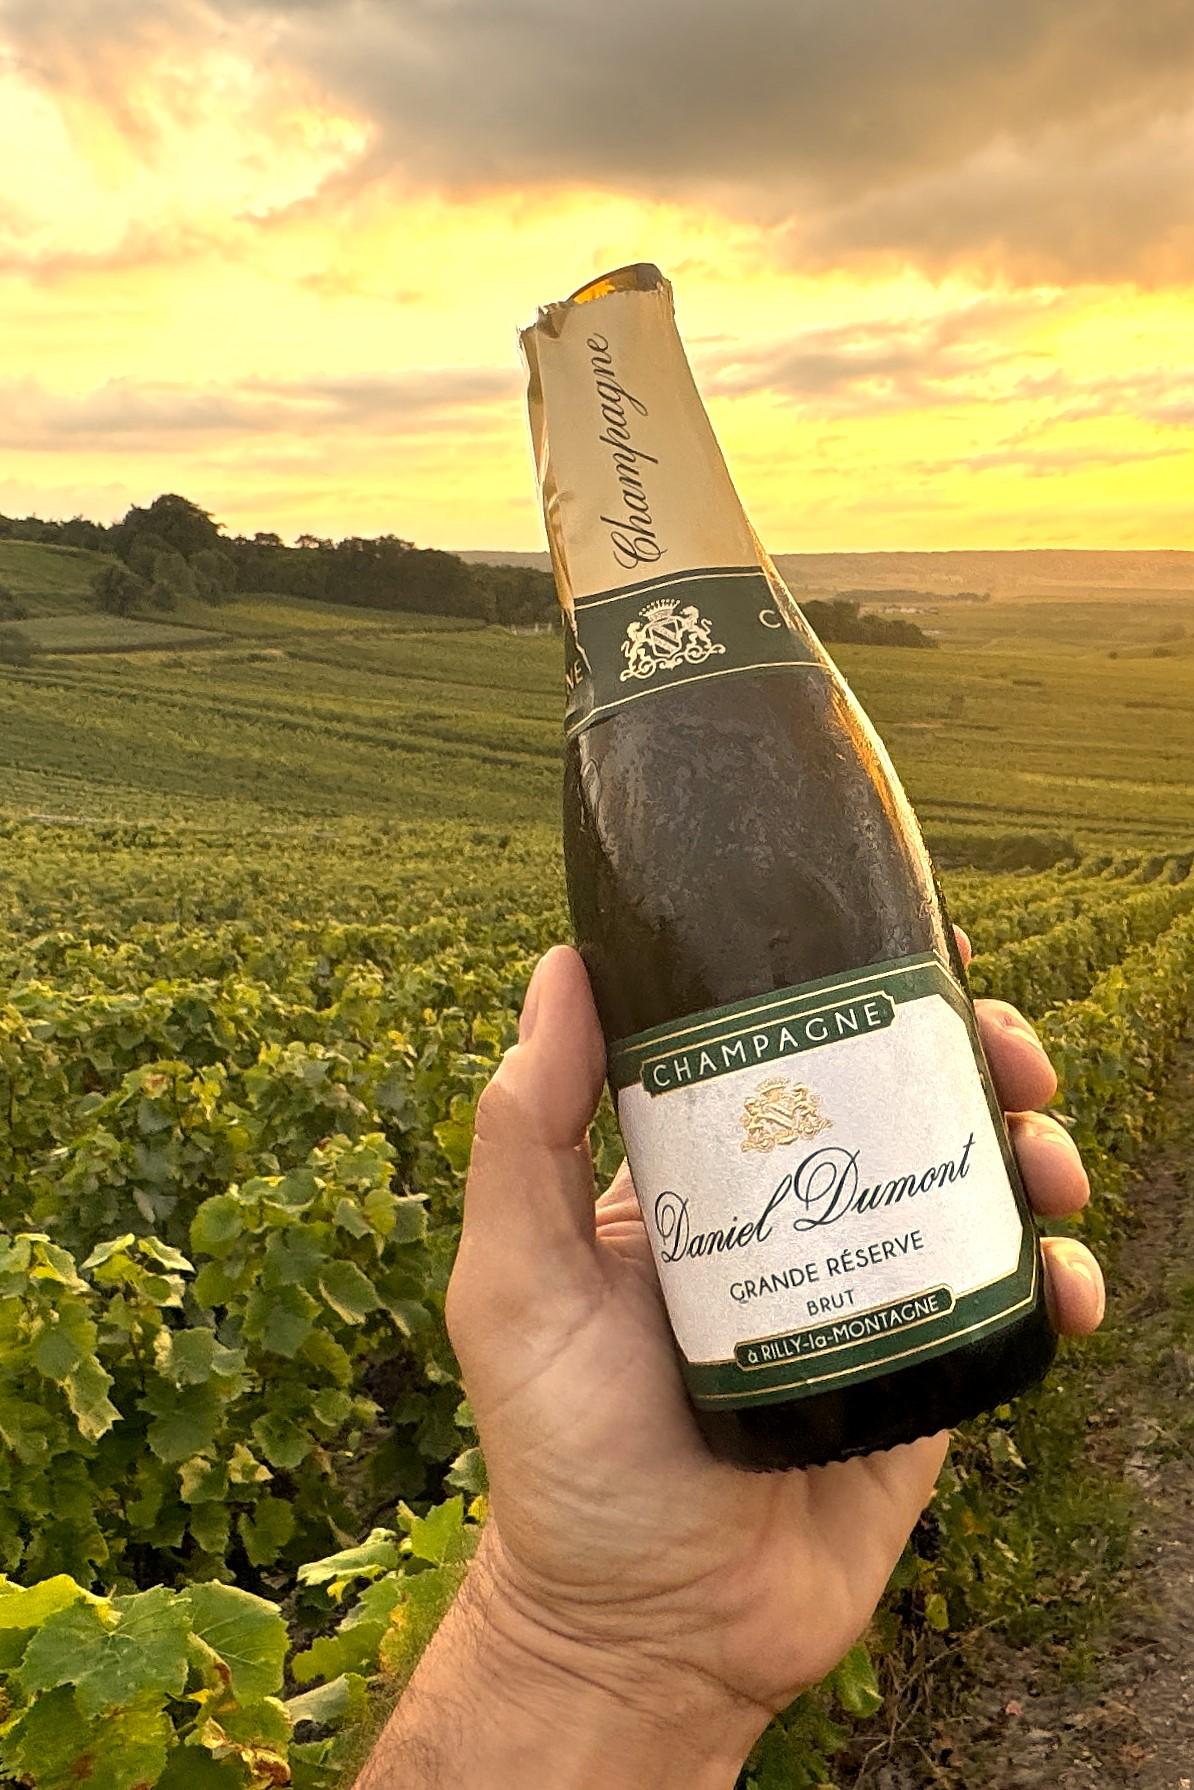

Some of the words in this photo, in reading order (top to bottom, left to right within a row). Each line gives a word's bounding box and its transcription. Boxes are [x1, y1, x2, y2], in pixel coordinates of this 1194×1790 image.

[586, 332, 668, 570] Champagne
[651, 1001, 885, 1088] CHAMPAGNE
[655, 1173, 793, 1264] Daniel
[793, 1132, 976, 1232] Dumont
[730, 1263, 819, 1302] GRANDE
[826, 1230, 924, 1277] RÉSERVE
[807, 1289, 854, 1316] BRUT
[747, 1348, 758, 1363] à
[761, 1294, 939, 1361] RILLY-la-MONTAGNE
